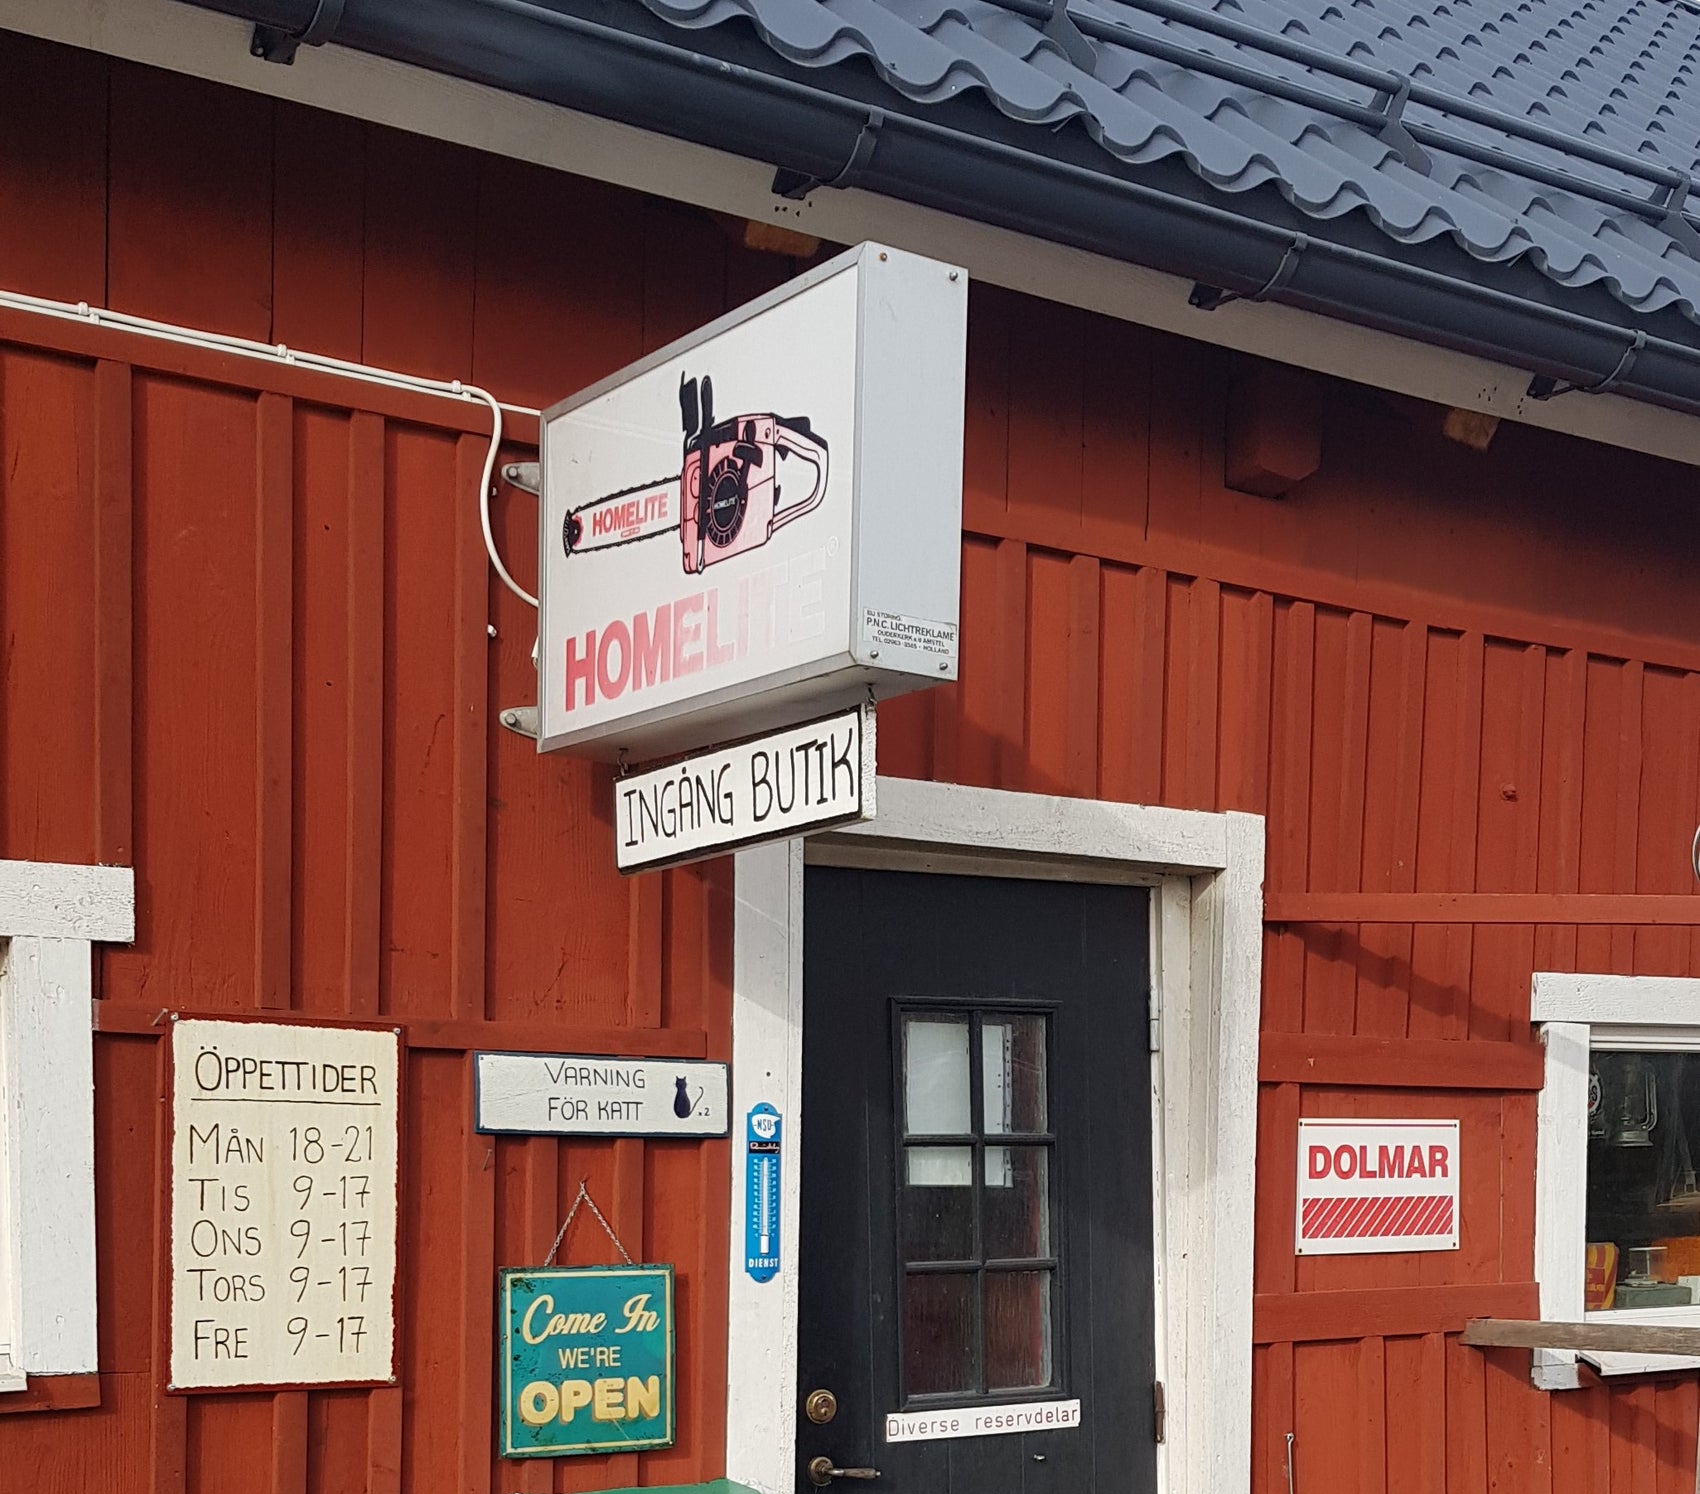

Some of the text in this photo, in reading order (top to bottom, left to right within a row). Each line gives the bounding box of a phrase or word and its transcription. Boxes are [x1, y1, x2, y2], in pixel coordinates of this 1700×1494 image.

[592, 493, 669, 537] HOMELITE
[890, 619, 955, 642] LICHTREKLAME
[623, 727, 855, 847] INGÅNG BUTIK
[194, 1045, 378, 1095] ÖPPETTIDER
[543, 1060, 646, 1089] VARNING
[547, 1096, 644, 1122] FÖR KATT
[189, 1122, 374, 1165] MÅN 18-21
[1308, 1144, 1449, 1180] DOLMAR
[187, 1174, 371, 1212] TIS 9-17
[190, 1219, 373, 1259] ONS 9-17
[748, 1257, 779, 1268] DIENST
[186, 1266, 373, 1303] TORS 9-17
[193, 1316, 368, 1360] FRE 9-17
[522, 1293, 661, 1345] Come In
[558, 1346, 621, 1369] WE'RE
[518, 1375, 661, 1425] OPEN
[888, 1405, 1079, 1437] Diverse reservdelar
